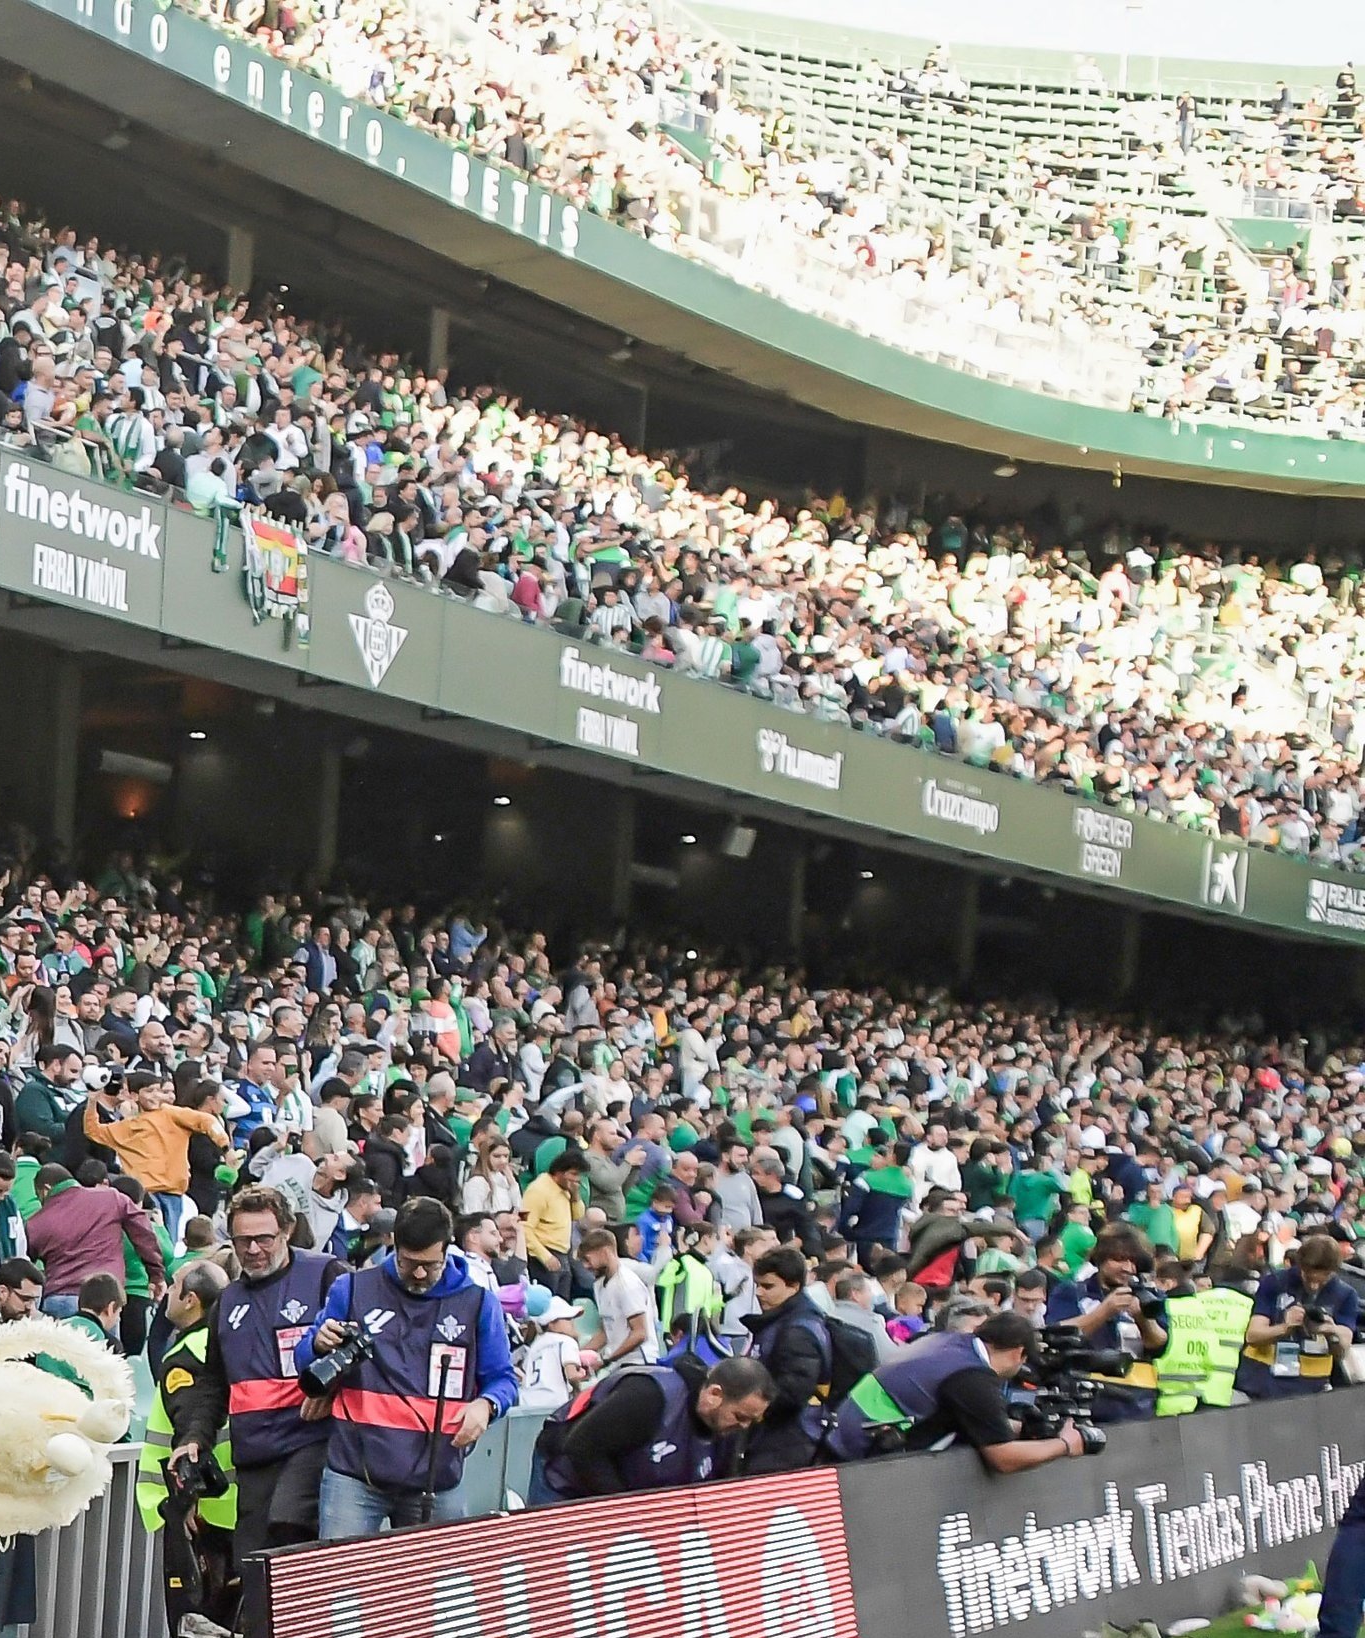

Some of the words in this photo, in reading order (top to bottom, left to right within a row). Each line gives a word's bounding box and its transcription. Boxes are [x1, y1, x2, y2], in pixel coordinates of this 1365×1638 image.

[450, 151, 580, 248] BETIS
[4, 462, 162, 560] finetwork
[32, 542, 75, 597] FIBRA
[559, 645, 662, 714] finetwork
[1133, 1471, 1246, 1585] Tiendas
[1240, 1459, 1323, 1555] Phone
